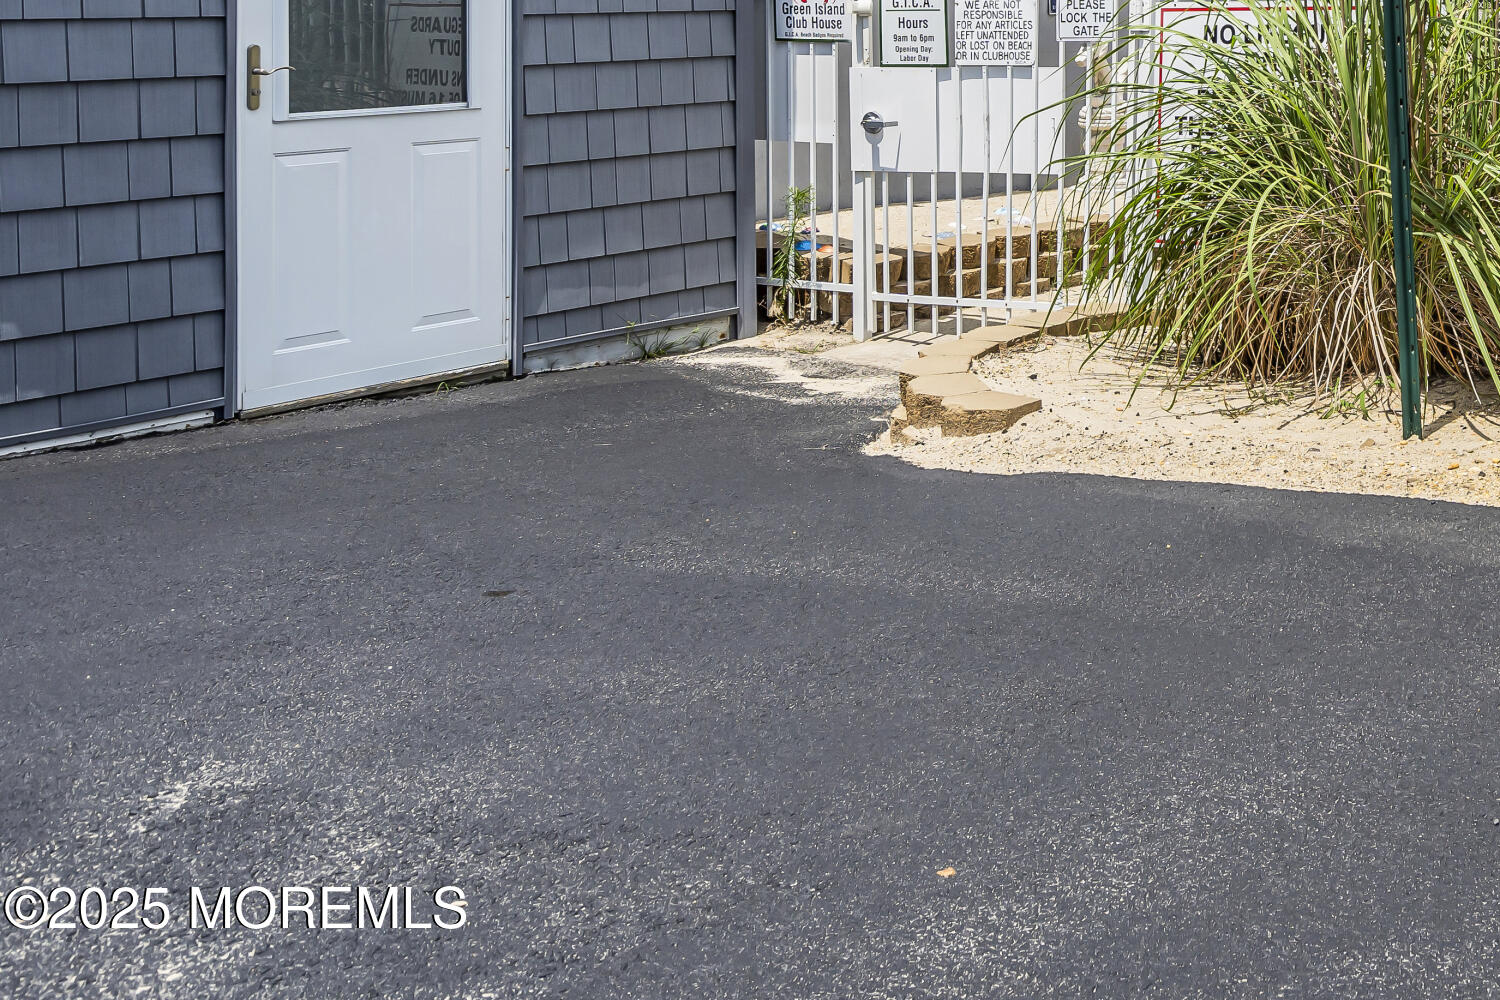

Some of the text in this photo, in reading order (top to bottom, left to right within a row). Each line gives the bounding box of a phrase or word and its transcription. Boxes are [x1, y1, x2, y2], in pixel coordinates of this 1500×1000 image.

[782, 2, 845, 16] Green Island
[965, 0, 1021, 9] WE ARE NOT
[1066, 0, 1106, 10] PLEASE
[963, 10, 1023, 20] RESPONSIBLE
[1060, 12, 1112, 23] LOCK THE
[785, 16, 842, 29] Club House
[898, 16, 929, 29] Hours
[956, 20, 1033, 30] FOR ANY ARTICLES
[956, 31, 1029, 40] LEFT UNATTENDED
[1073, 25, 1099, 36] GATE
[1203, 24, 1236, 44] NO
[893, 34, 935, 43] 9am to 6pm
[894, 45, 934, 54] Opening Day:
[956, 41, 1032, 50] OR LOST ON BEACH
[956, 51, 1031, 60] OR IN CLUBHOUSE
